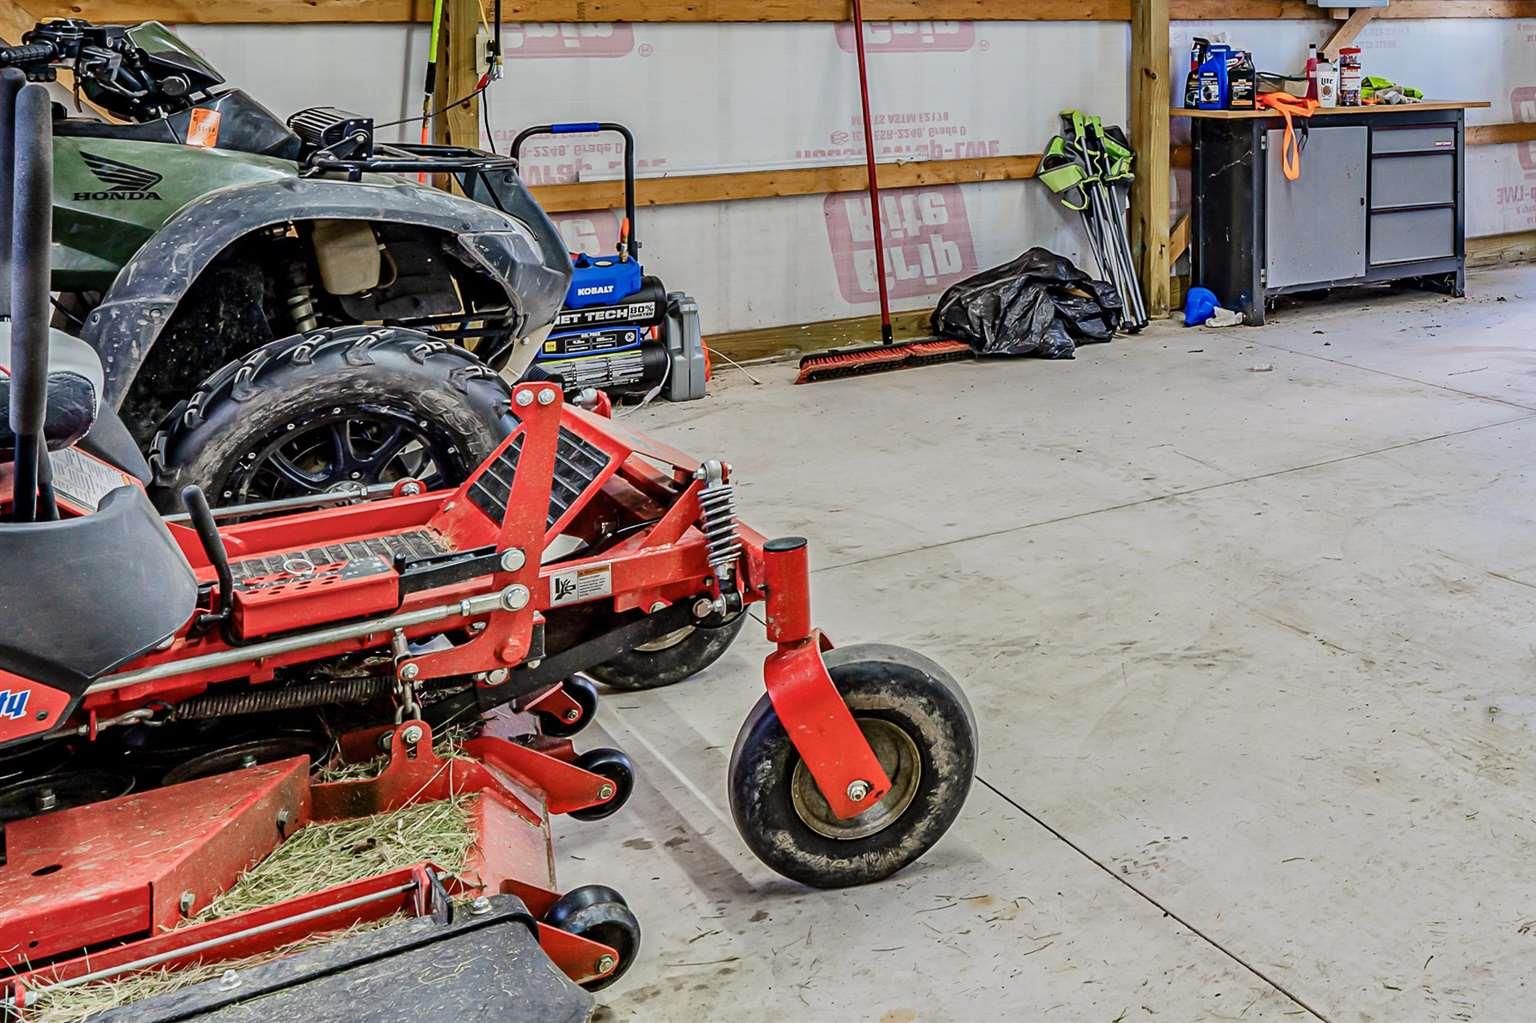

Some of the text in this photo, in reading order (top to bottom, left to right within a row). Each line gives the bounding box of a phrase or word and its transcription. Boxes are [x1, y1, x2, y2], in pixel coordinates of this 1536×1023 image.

[72, 191, 162, 201] HONDA
[577, 285, 615, 297] KOBALT
[630, 304, 654, 314] 80%
[585, 308, 629, 323] TECH
